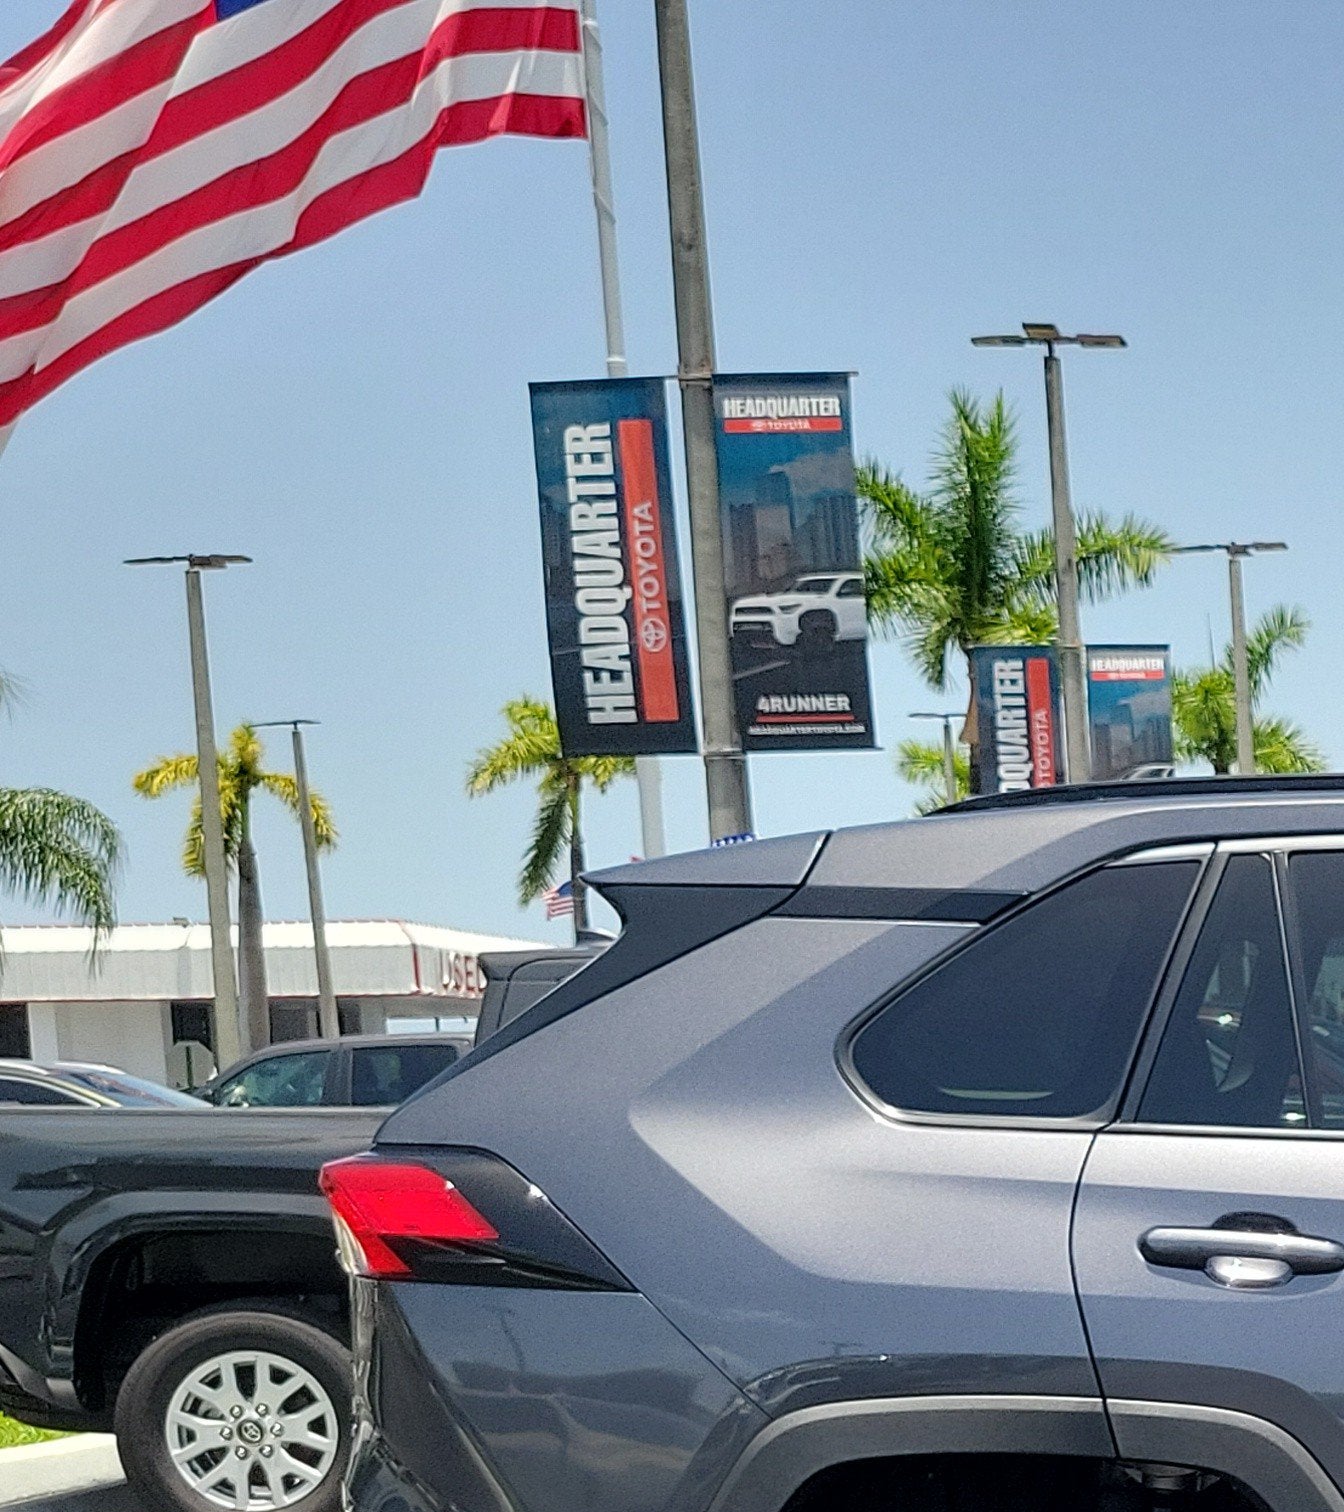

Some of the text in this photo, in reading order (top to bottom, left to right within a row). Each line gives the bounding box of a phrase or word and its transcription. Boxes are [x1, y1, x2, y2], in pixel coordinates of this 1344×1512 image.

[724, 396, 840, 419] HEADQUARTER
[564, 421, 638, 724] HEADQUARTER
[633, 501, 661, 610] TOYOTA
[1091, 657, 1165, 671] HEADQUARTER
[757, 694, 851, 713] 4RUNNER
[1033, 708, 1053, 782] TOYOTA
